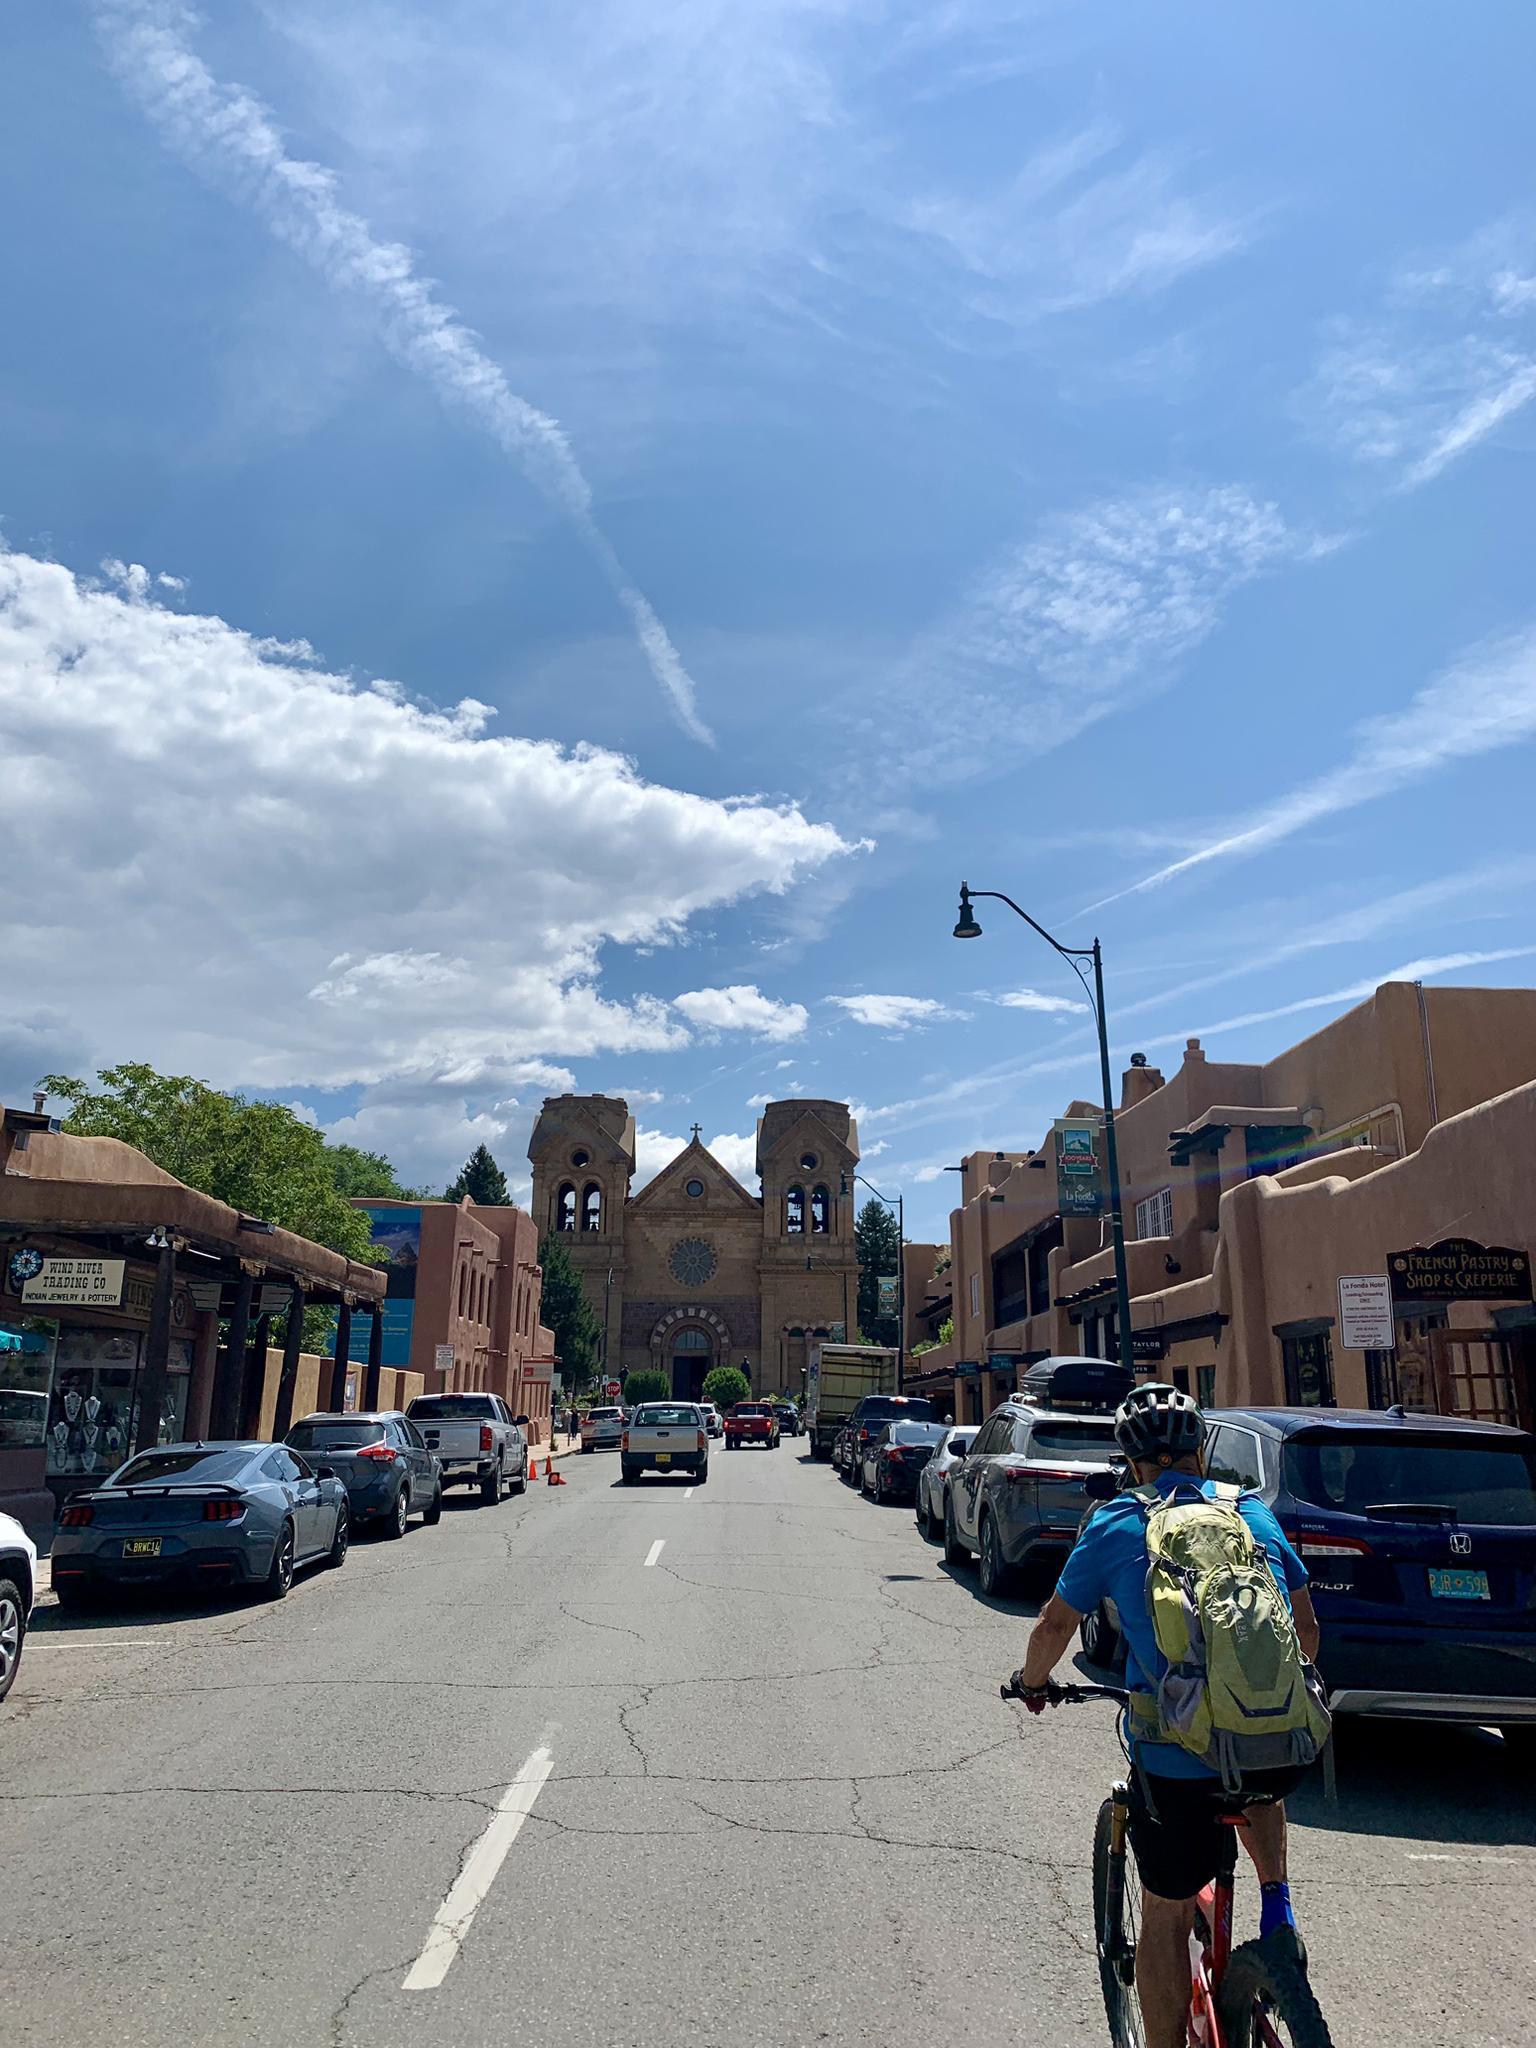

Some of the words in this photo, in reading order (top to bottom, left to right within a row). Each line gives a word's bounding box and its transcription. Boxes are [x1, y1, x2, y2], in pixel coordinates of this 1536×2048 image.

[50, 1262, 74, 1275] WIND
[76, 1262, 103, 1275] RIVER
[1408, 1254, 1457, 1271] FRENCH
[1460, 1254, 1509, 1271] PASTRY
[43, 1276, 88, 1289] TRADING
[93, 1276, 106, 1290] CO
[1406, 1271, 1441, 1289] SHOP
[1444, 1273, 1454, 1287] &
[25, 1292, 47, 1301] INDIAN
[49, 1293, 78, 1302] JEWELRY
[80, 1294, 86, 1302] &
[88, 1294, 117, 1302] POTTERY
[1309, 1581, 1355, 1591] PILOT
